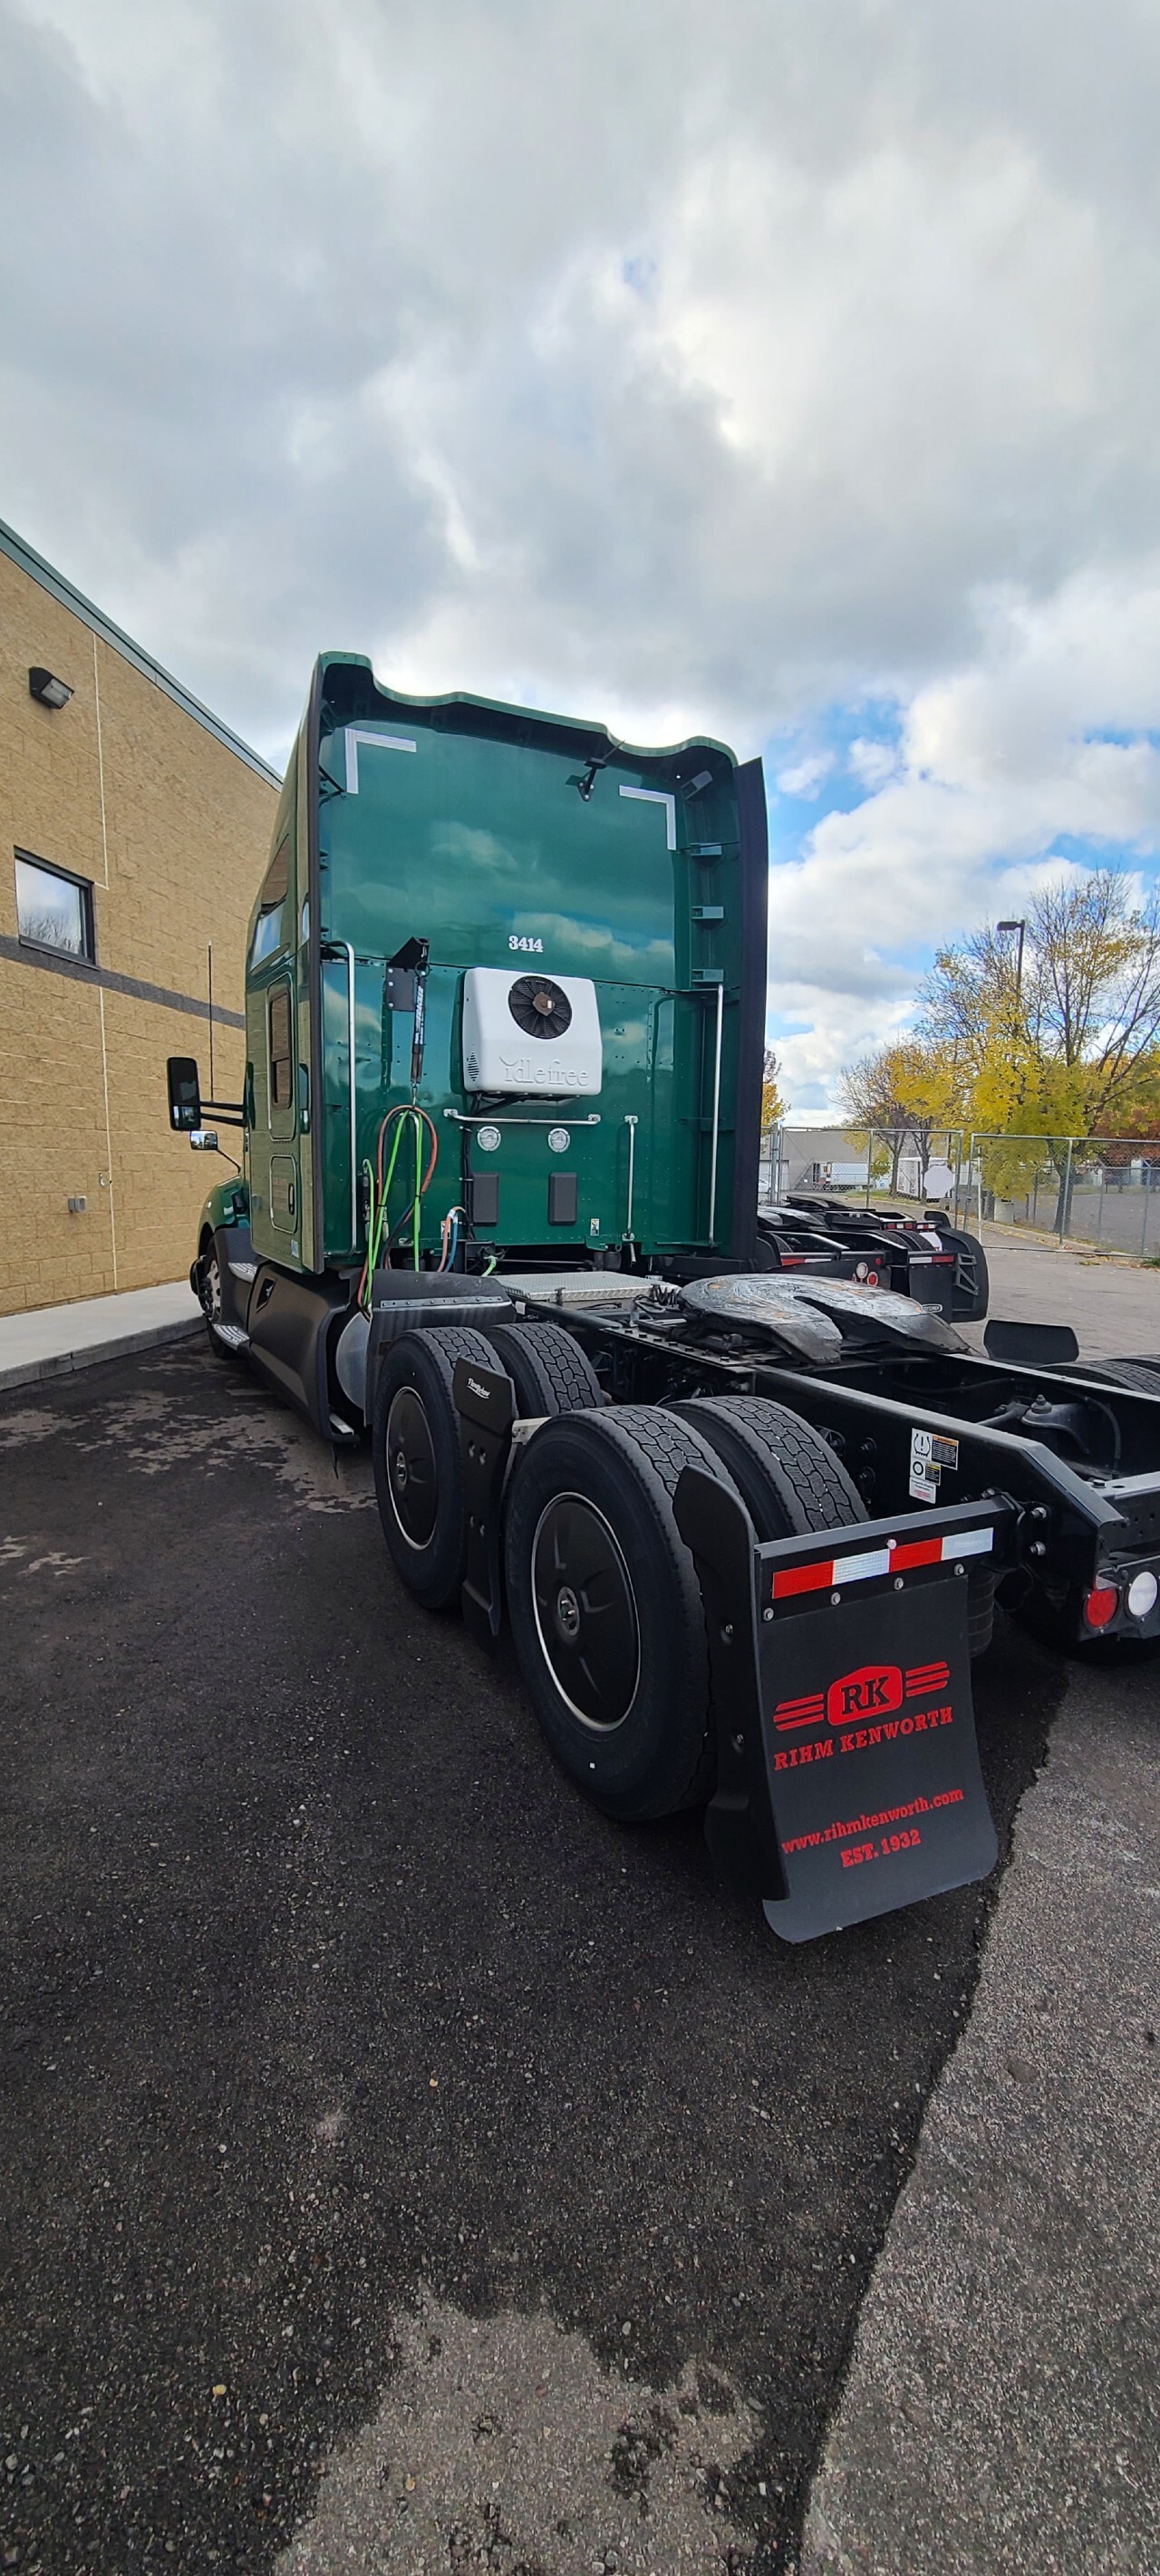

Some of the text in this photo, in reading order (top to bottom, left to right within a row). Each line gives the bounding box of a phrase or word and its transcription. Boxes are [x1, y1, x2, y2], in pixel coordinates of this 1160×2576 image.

[508, 935, 544, 954] 3414
[840, 1676, 890, 1715] RK
[774, 1706, 953, 1771] RIHM KENWORTH
[781, 1788, 964, 1854] www.rihmkenworth.com
[840, 1828, 922, 1868] EST. 1932
